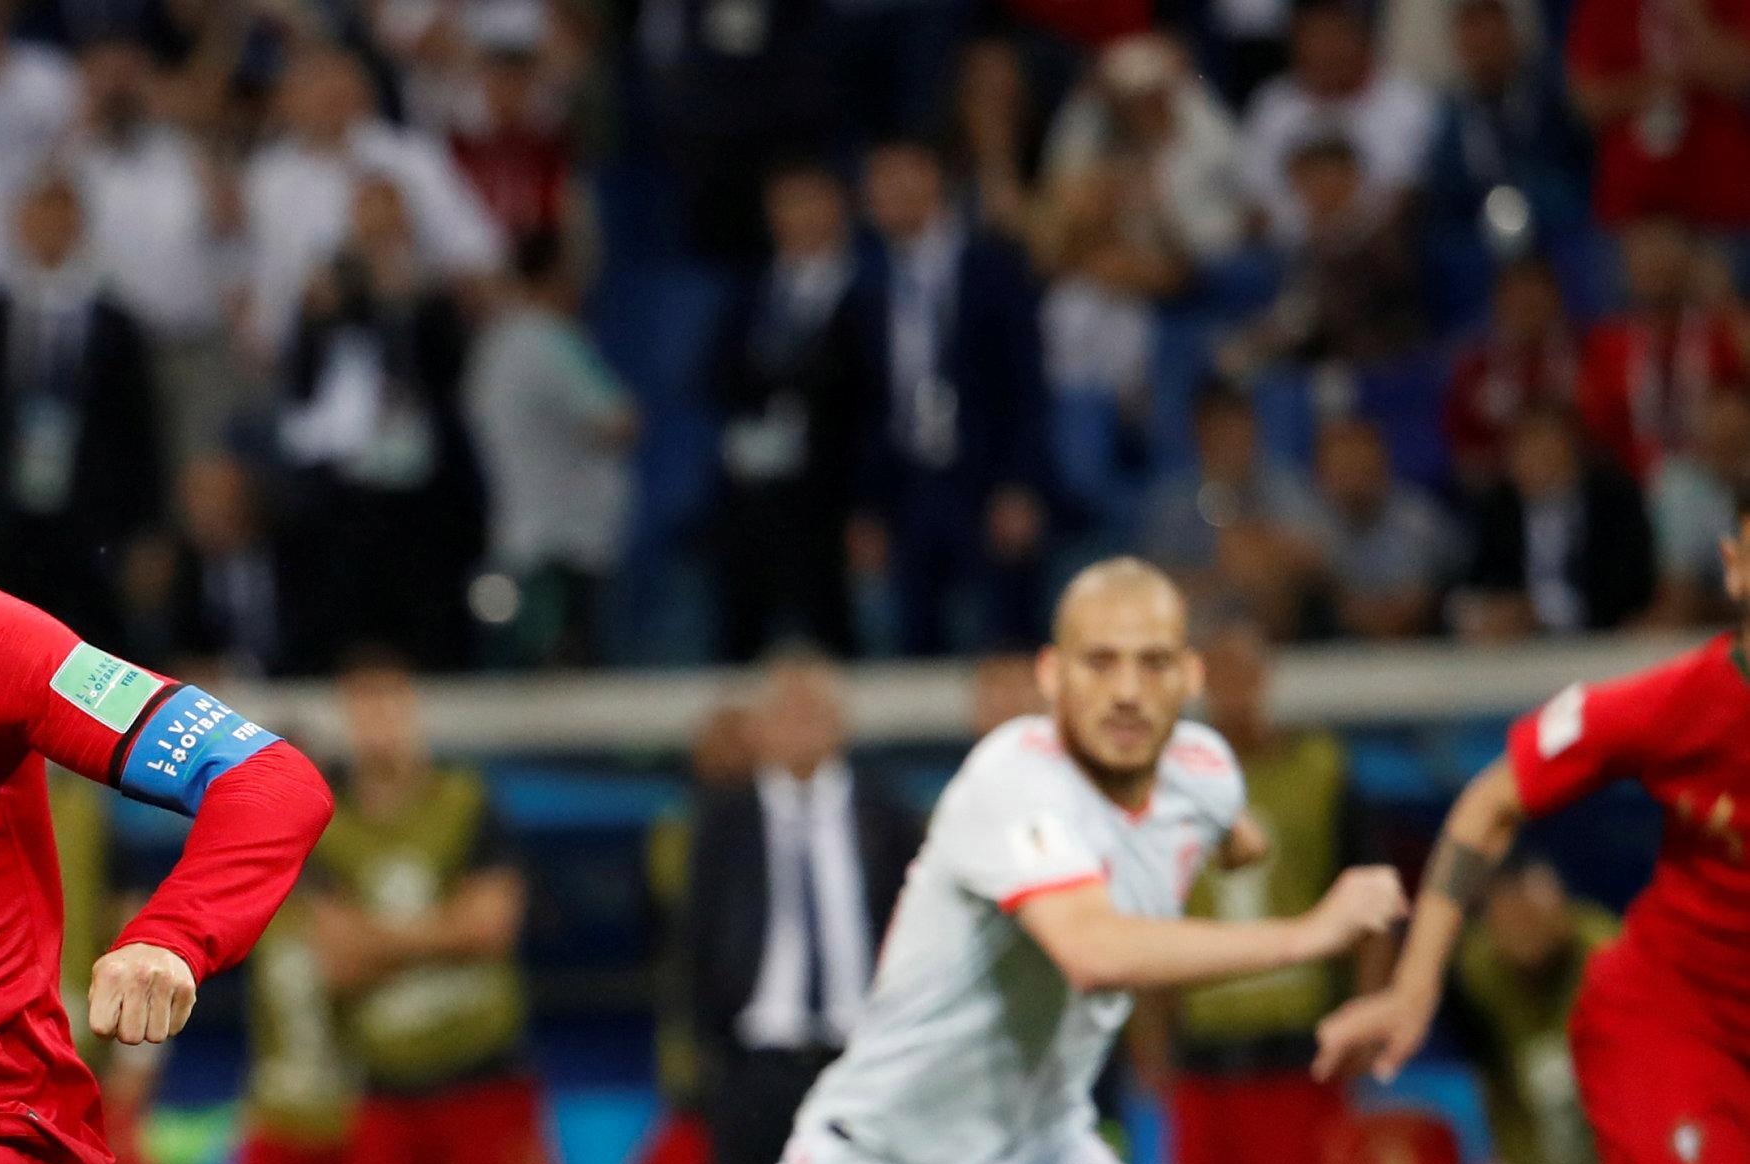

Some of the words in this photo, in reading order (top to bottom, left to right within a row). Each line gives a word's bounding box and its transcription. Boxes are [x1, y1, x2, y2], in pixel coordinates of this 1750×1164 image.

[76, 656, 113, 700] LIVING
[120, 671, 139, 686] FIFA
[146, 695, 219, 770] LIVIN
[163, 704, 233, 778] FOOTBAL
